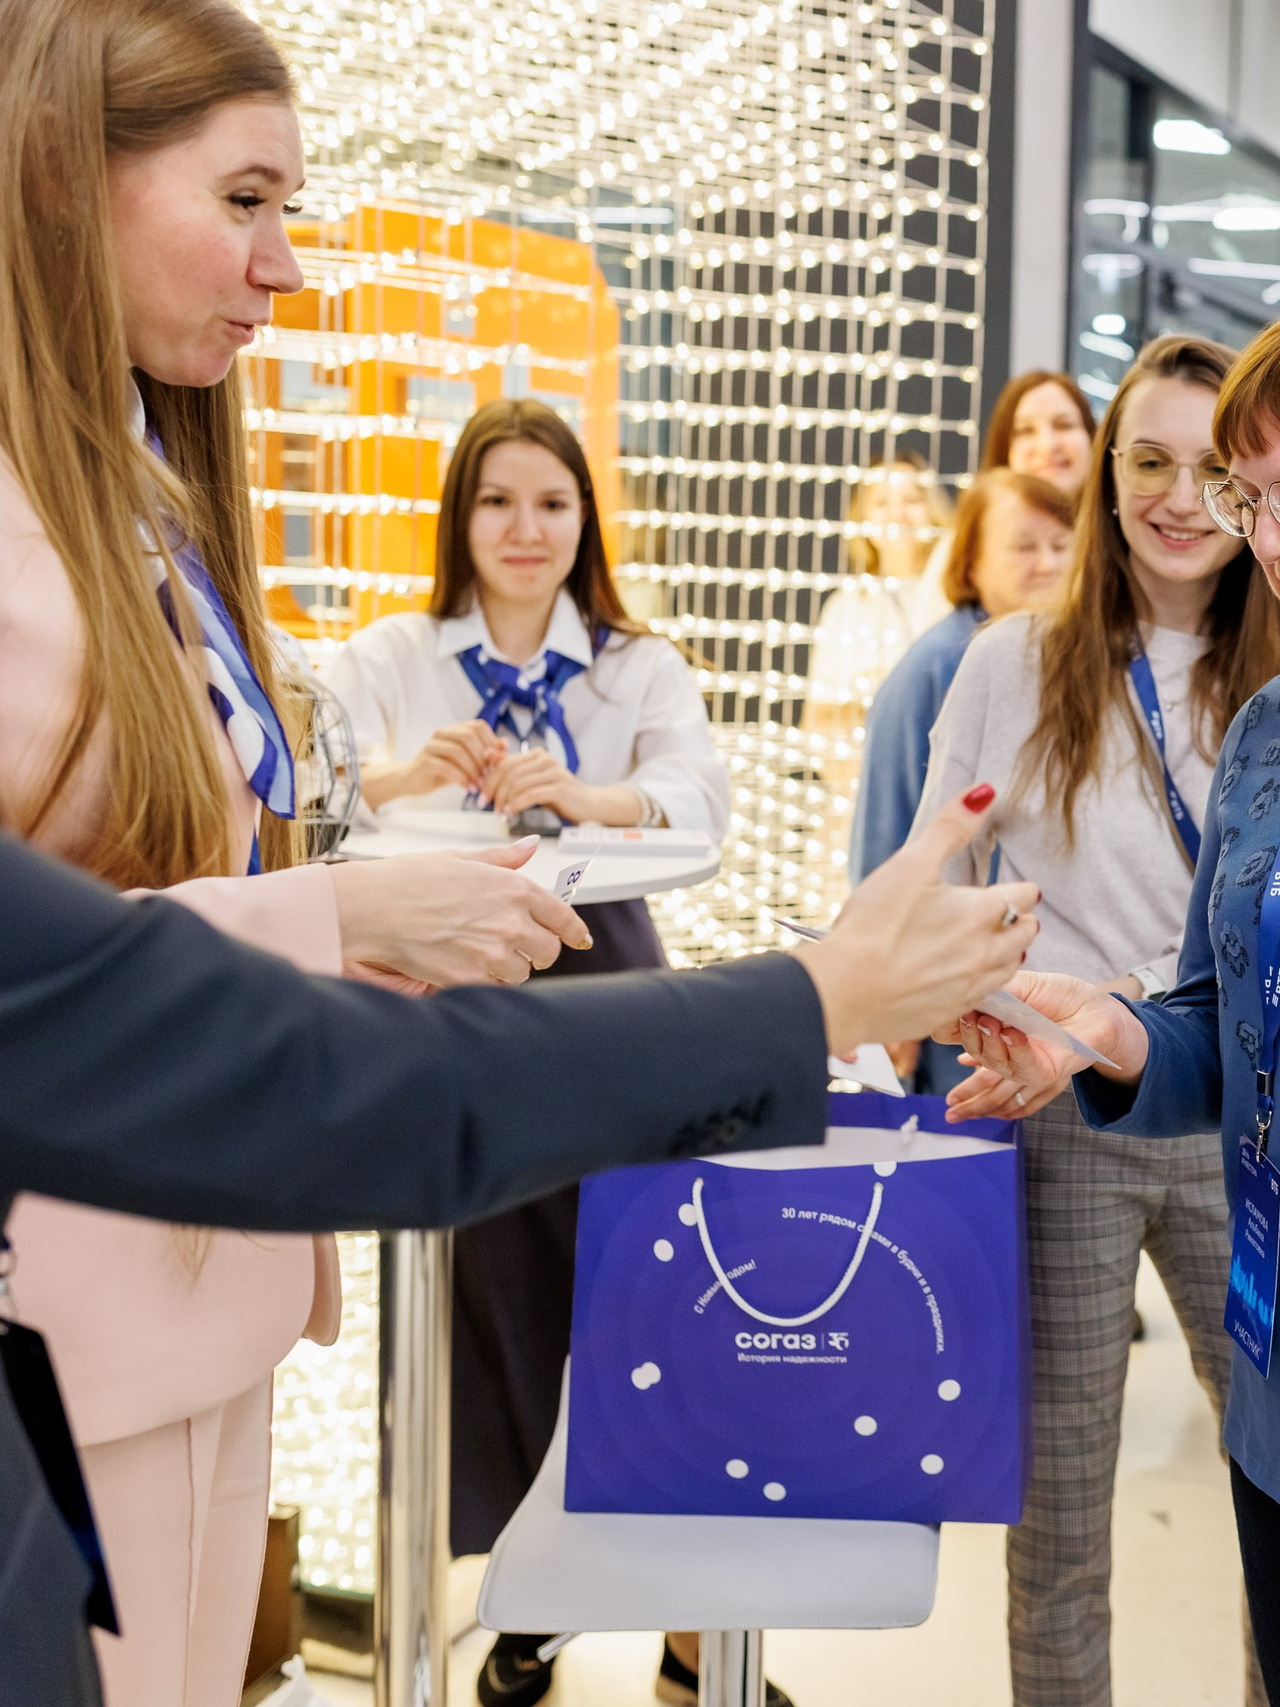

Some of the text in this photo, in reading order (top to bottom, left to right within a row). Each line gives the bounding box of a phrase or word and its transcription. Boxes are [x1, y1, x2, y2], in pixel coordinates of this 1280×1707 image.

[781, 1207, 796, 1219] 30
[798, 1209, 819, 1220] лет
[819, 1213, 857, 1229] рядом
[726, 1258, 757, 1280] одом!
[735, 1332, 817, 1350] согаз
[737, 1352, 848, 1365] История надежности
